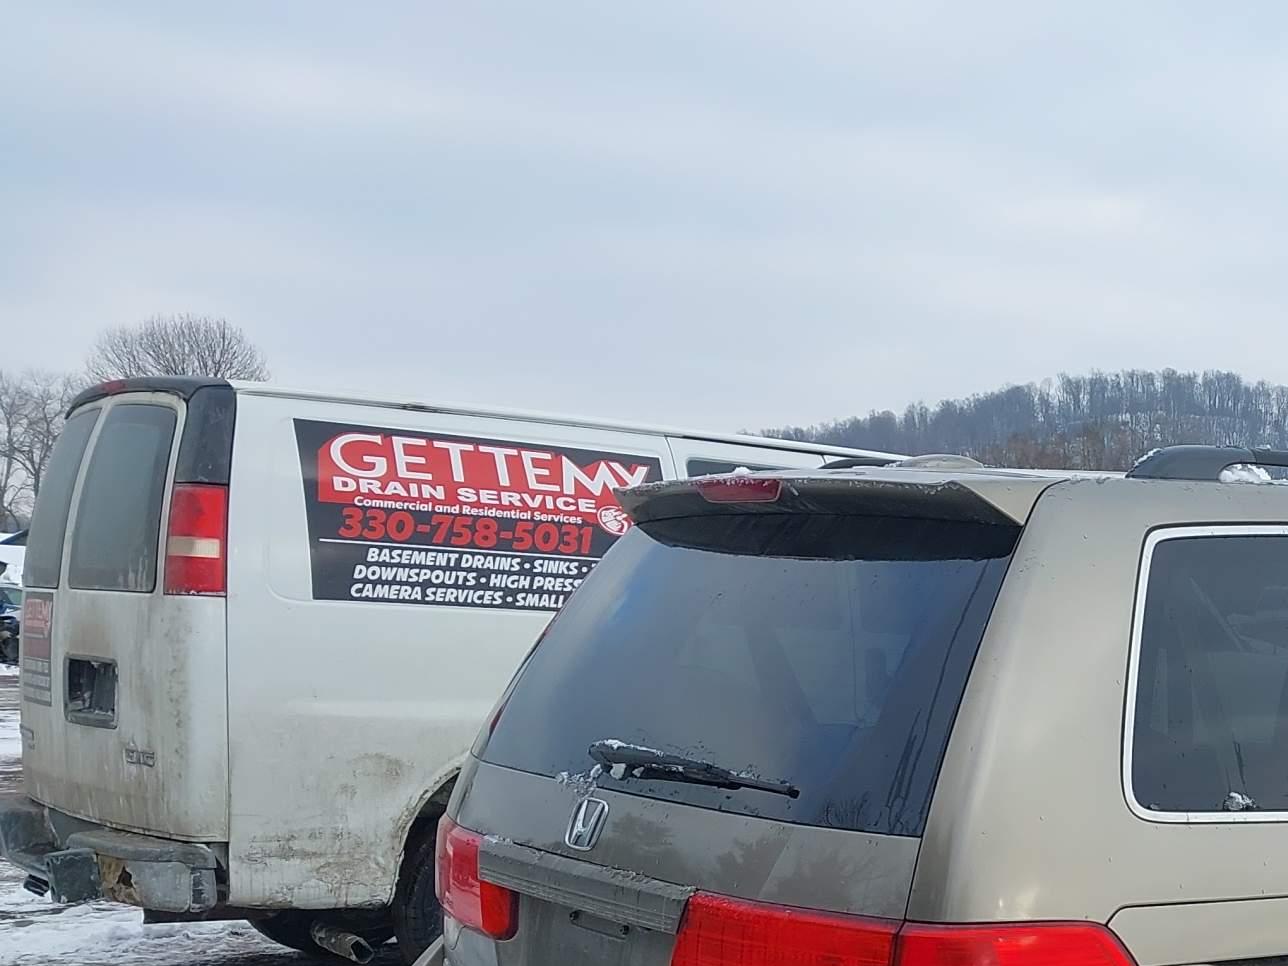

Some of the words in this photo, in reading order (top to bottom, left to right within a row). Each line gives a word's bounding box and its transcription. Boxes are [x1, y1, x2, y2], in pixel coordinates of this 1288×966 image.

[329, 433, 649, 497] GETTEMY
[333, 476, 445, 501] DRAIN
[457, 487, 597, 513] SERVICE
[354, 496, 432, 511] Commercial
[435, 503, 459, 514] and
[462, 506, 531, 520] Residential
[533, 512, 582, 524] Services
[338, 507, 594, 555] 330-758-5031
[367, 548, 459, 567] BASEMENT
[461, 555, 521, 571] DRAINS
[533, 560, 579, 575] SINKS
[353, 564, 476, 586] DOWNSPOUTS
[489, 574, 530, 589] HIGH
[350, 583, 422, 600] CAMERA
[425, 587, 503, 605] SERVICES
